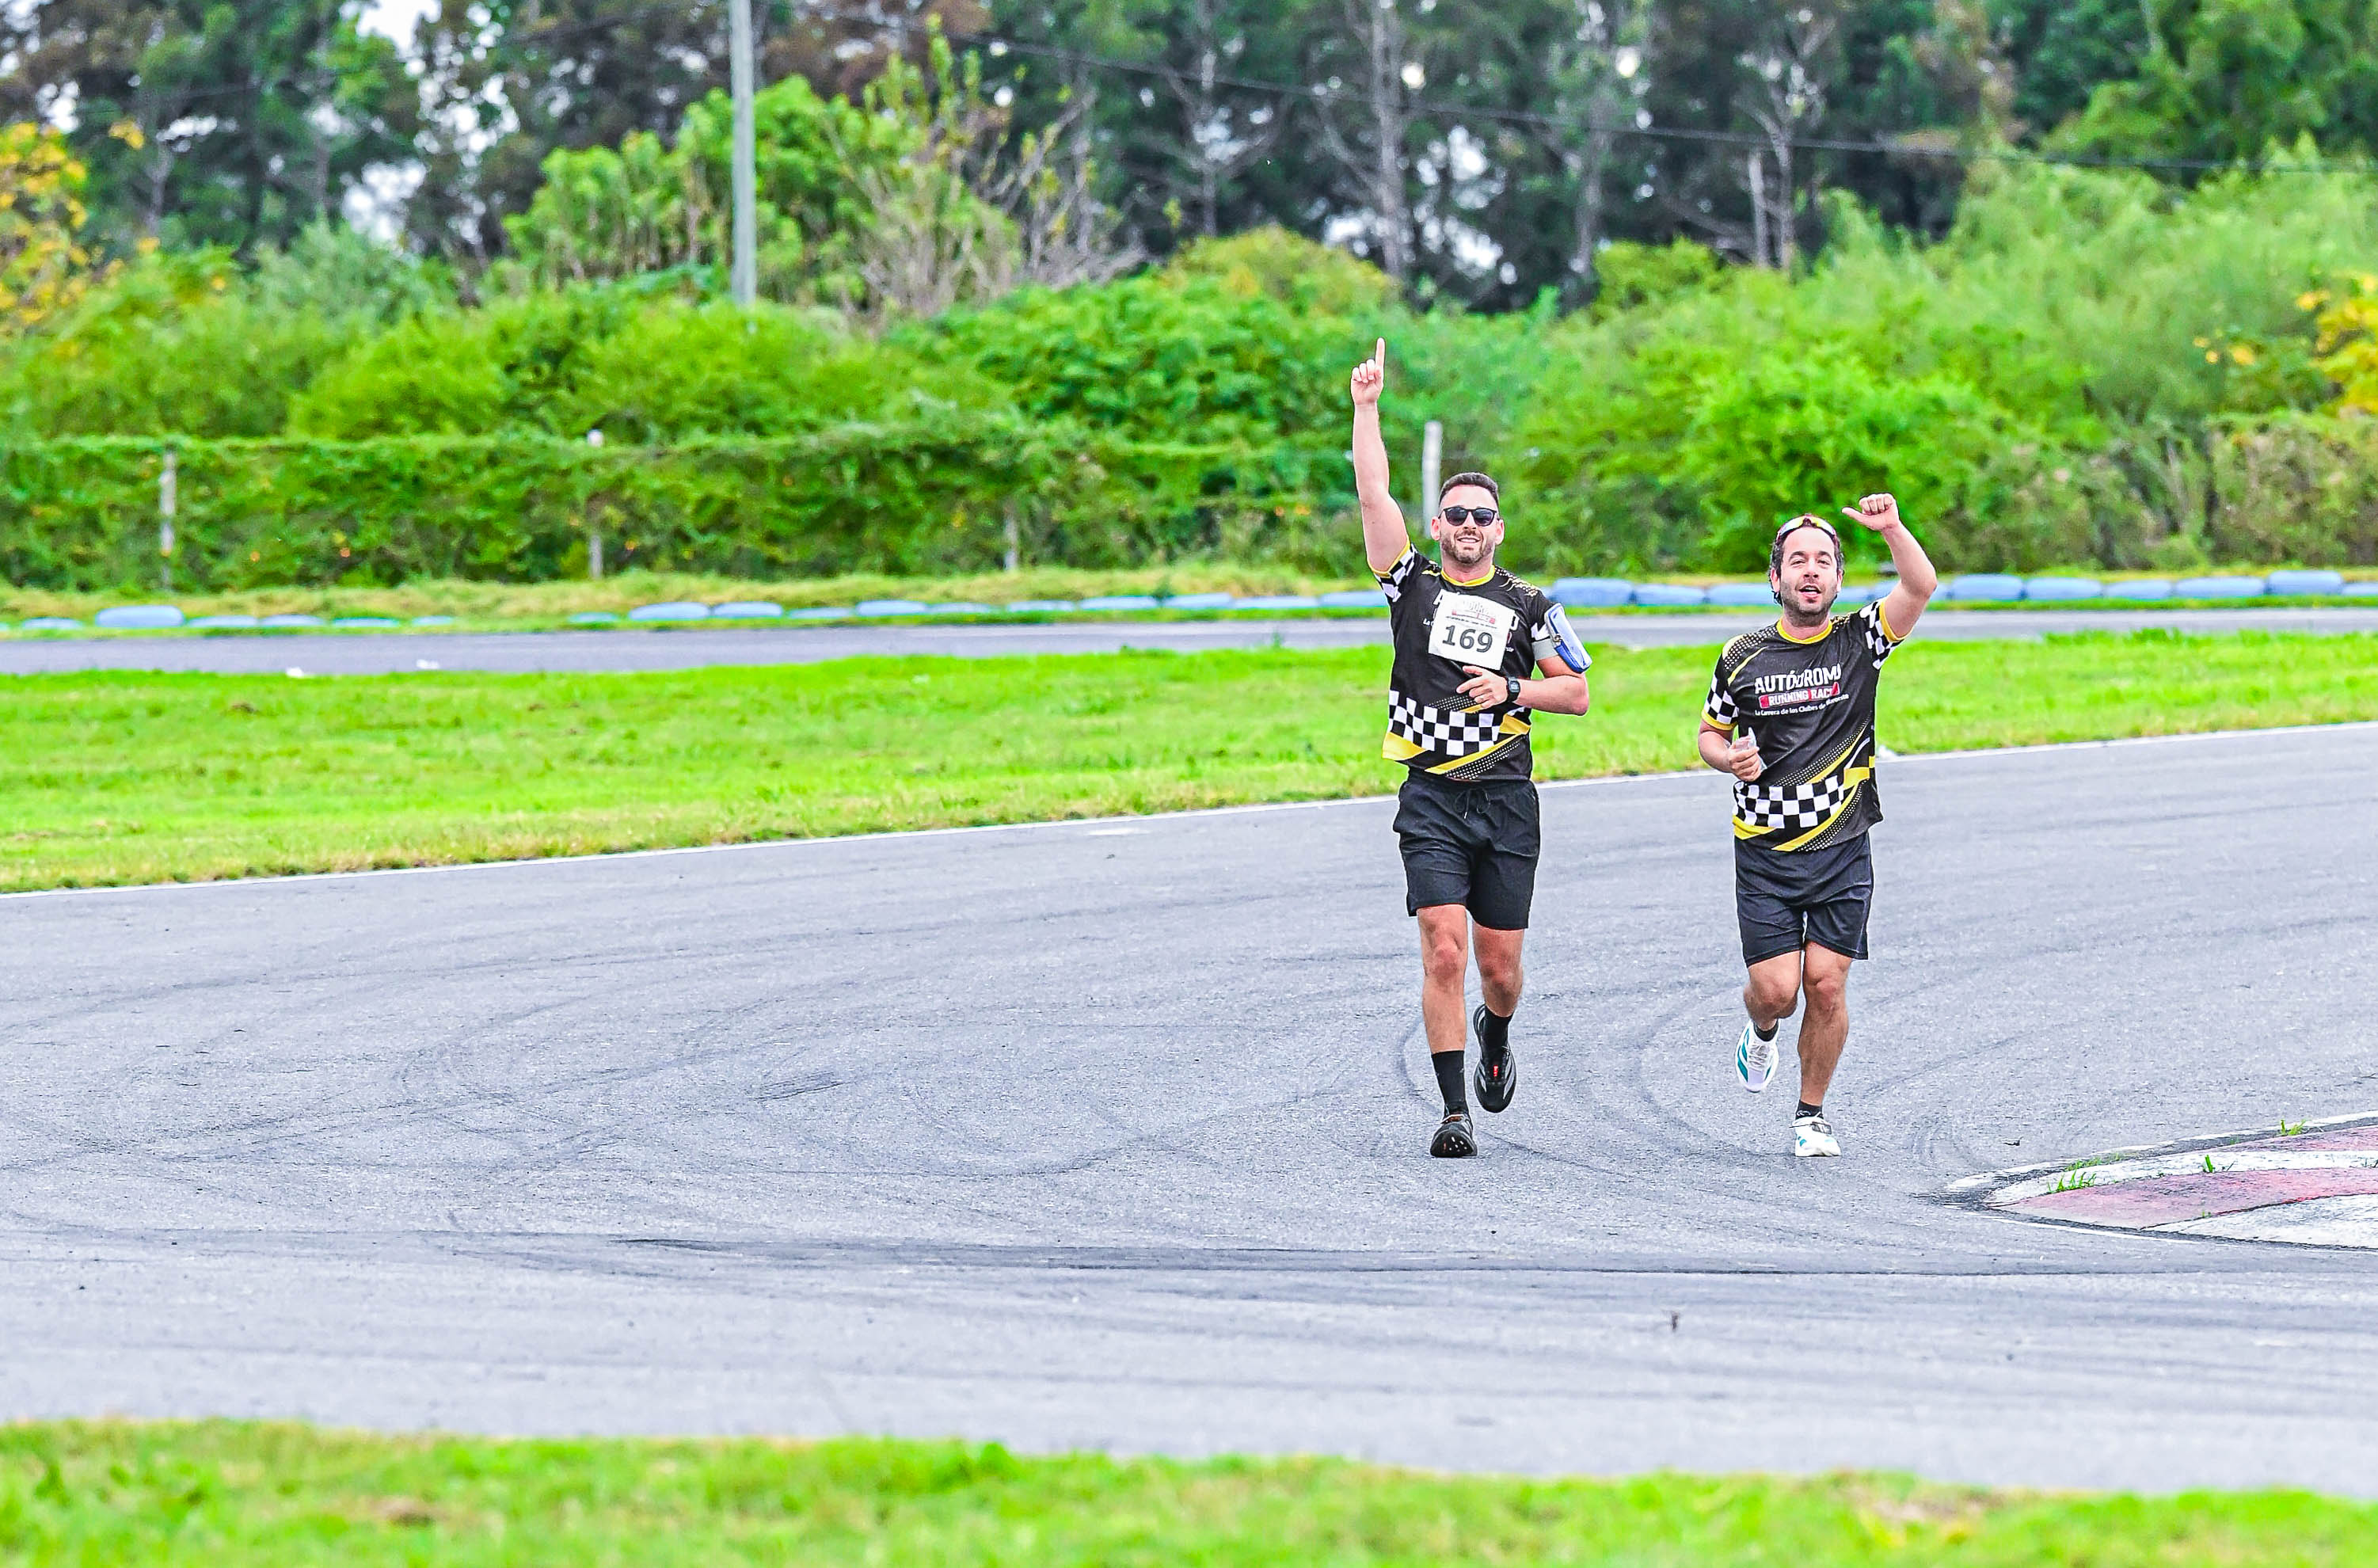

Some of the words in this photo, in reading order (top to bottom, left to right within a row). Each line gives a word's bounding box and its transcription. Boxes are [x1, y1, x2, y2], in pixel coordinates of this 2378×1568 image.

[1442, 625, 1493, 653] 169
[1768, 690, 1809, 706] RUNNING
[1811, 688, 1832, 699] RAC
